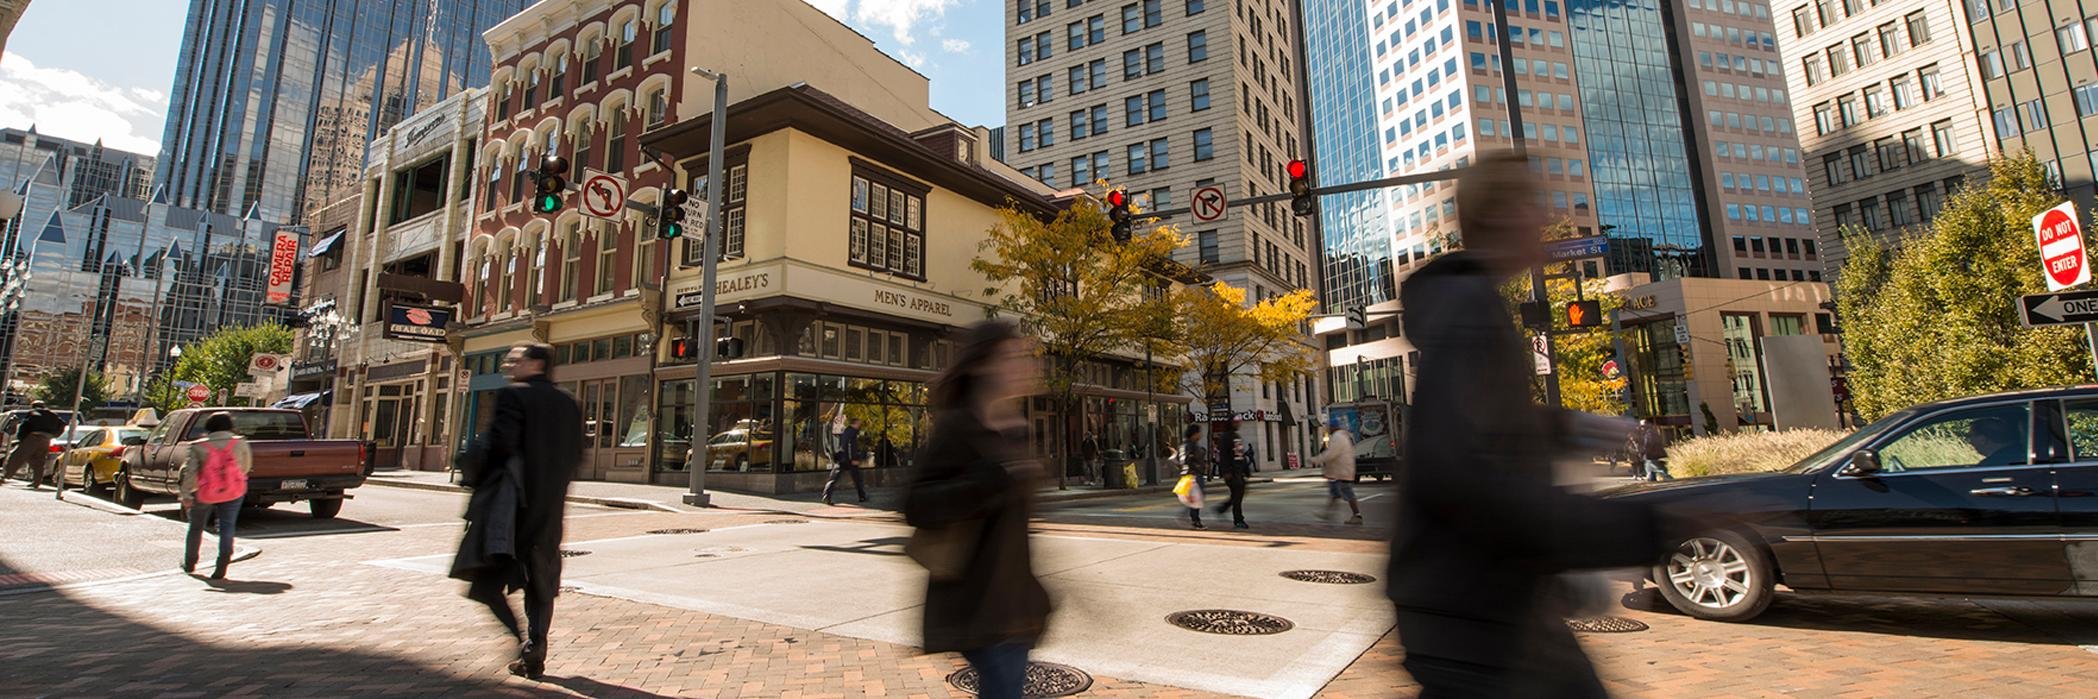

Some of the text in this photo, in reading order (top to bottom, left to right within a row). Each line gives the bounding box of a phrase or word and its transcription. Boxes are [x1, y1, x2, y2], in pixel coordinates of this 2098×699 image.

[688, 199, 700, 209] NO
[690, 219, 704, 229] RED
[2041, 219, 2072, 242] DO NOT
[270, 235, 287, 287] CAMERA
[281, 239, 297, 283] REPAIR
[1552, 245, 1602, 259] Market St
[2051, 255, 2079, 274] ENTER
[714, 272, 769, 295] HEALEY'S
[874, 289, 953, 317] MEN'S APPAREL
[2063, 300, 2098, 314] ONE
[189, 388, 208, 397] STOP
